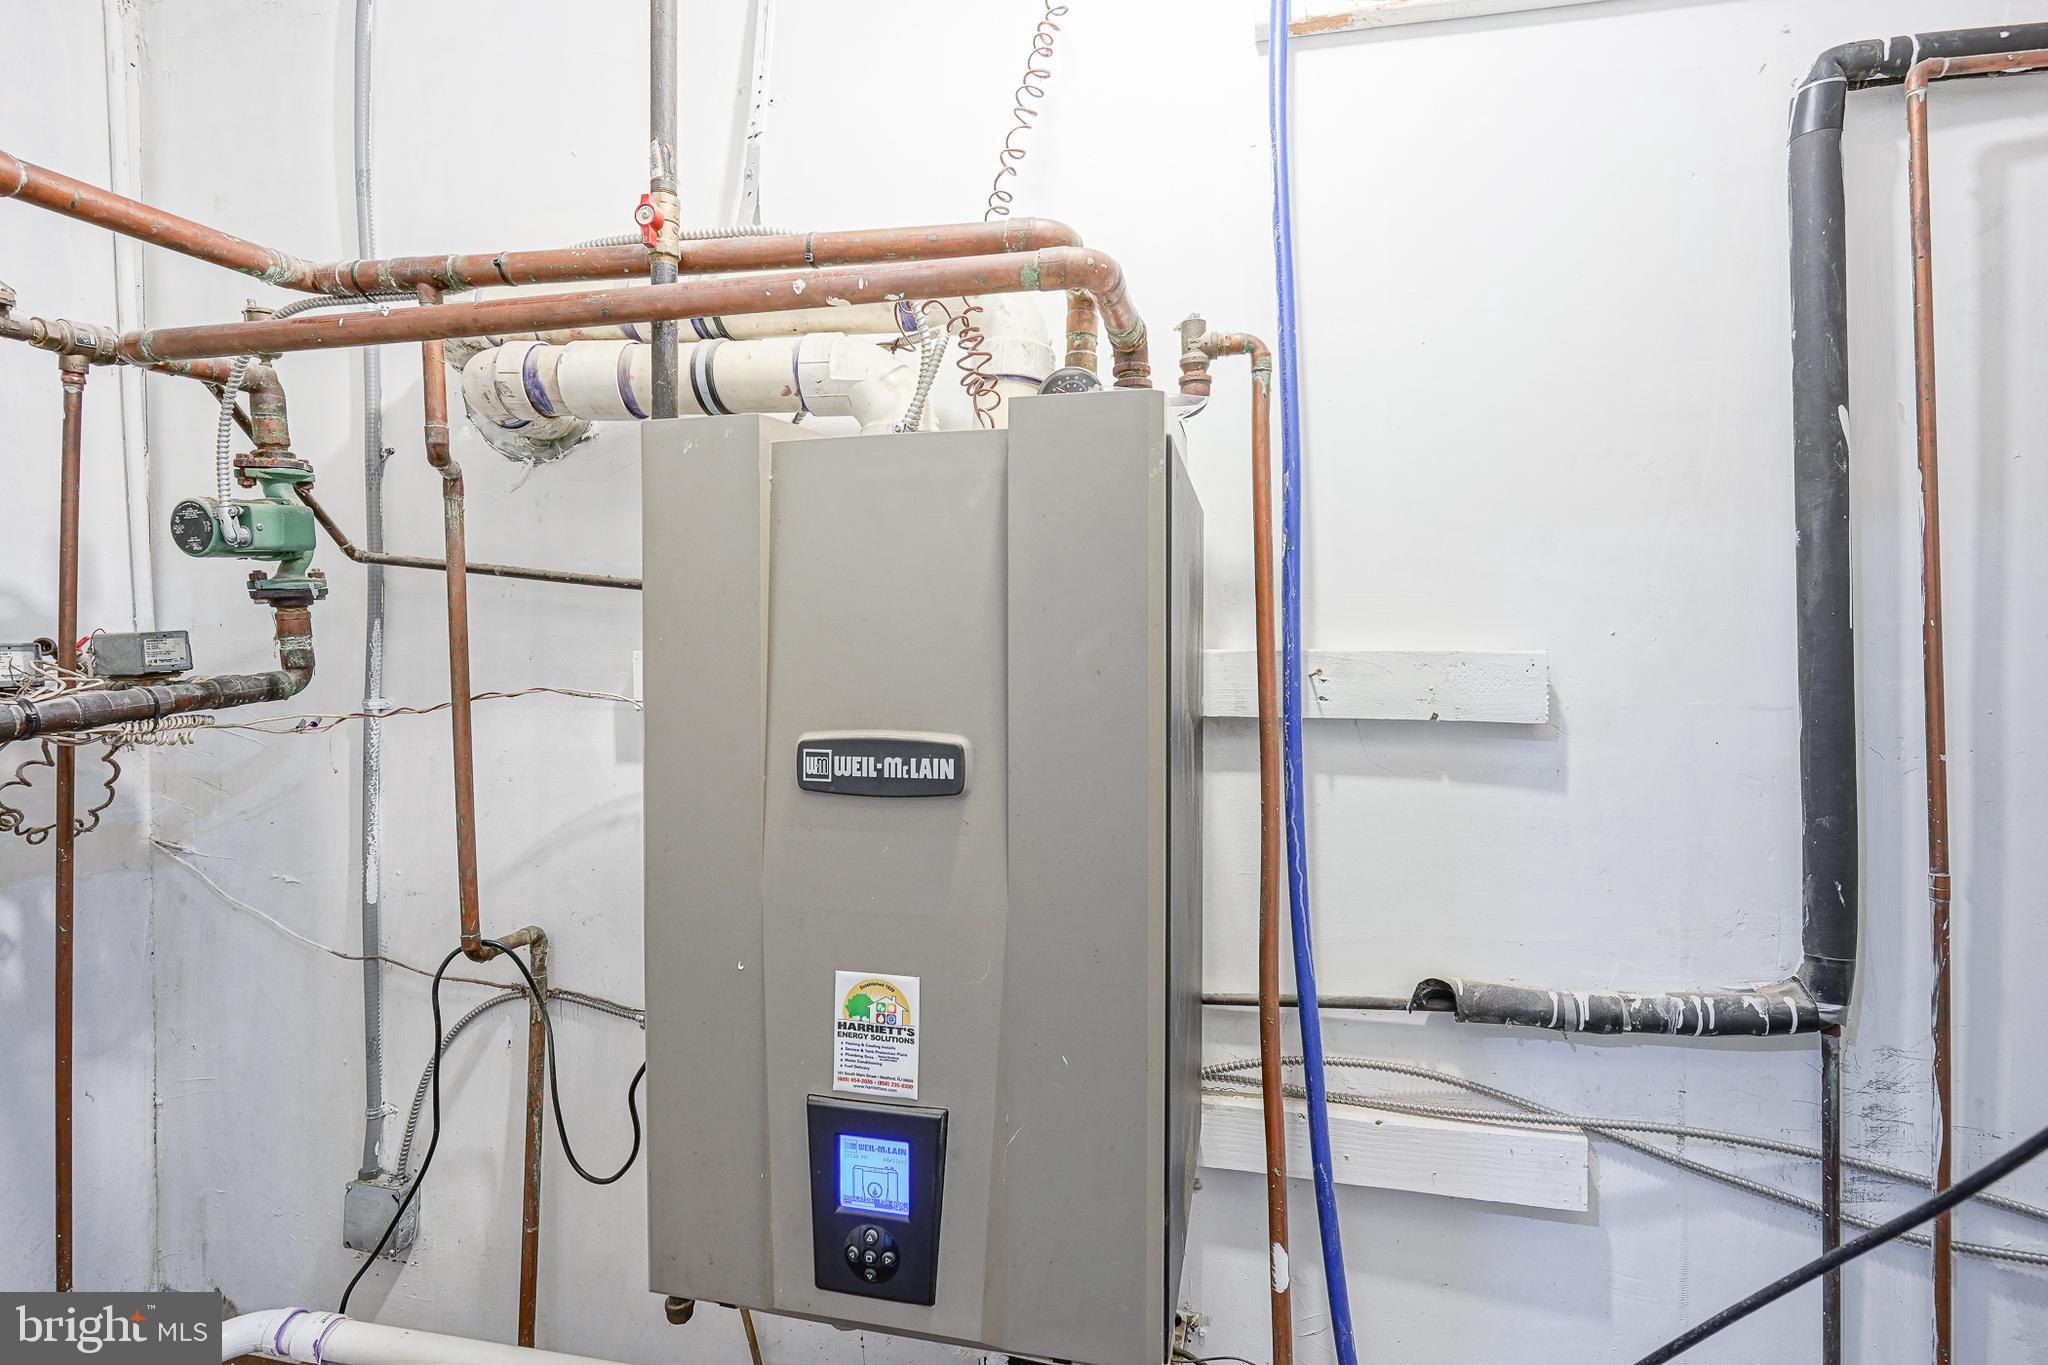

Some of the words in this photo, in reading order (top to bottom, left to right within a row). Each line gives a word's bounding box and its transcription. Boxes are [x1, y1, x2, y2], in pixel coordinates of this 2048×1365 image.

[860, 982, 884, 990] Established
[838, 1022, 915, 1036] HARRIETT'S
[838, 1031, 868, 1040] ENERGY
[870, 1034, 915, 1044] SOLUTIONS
